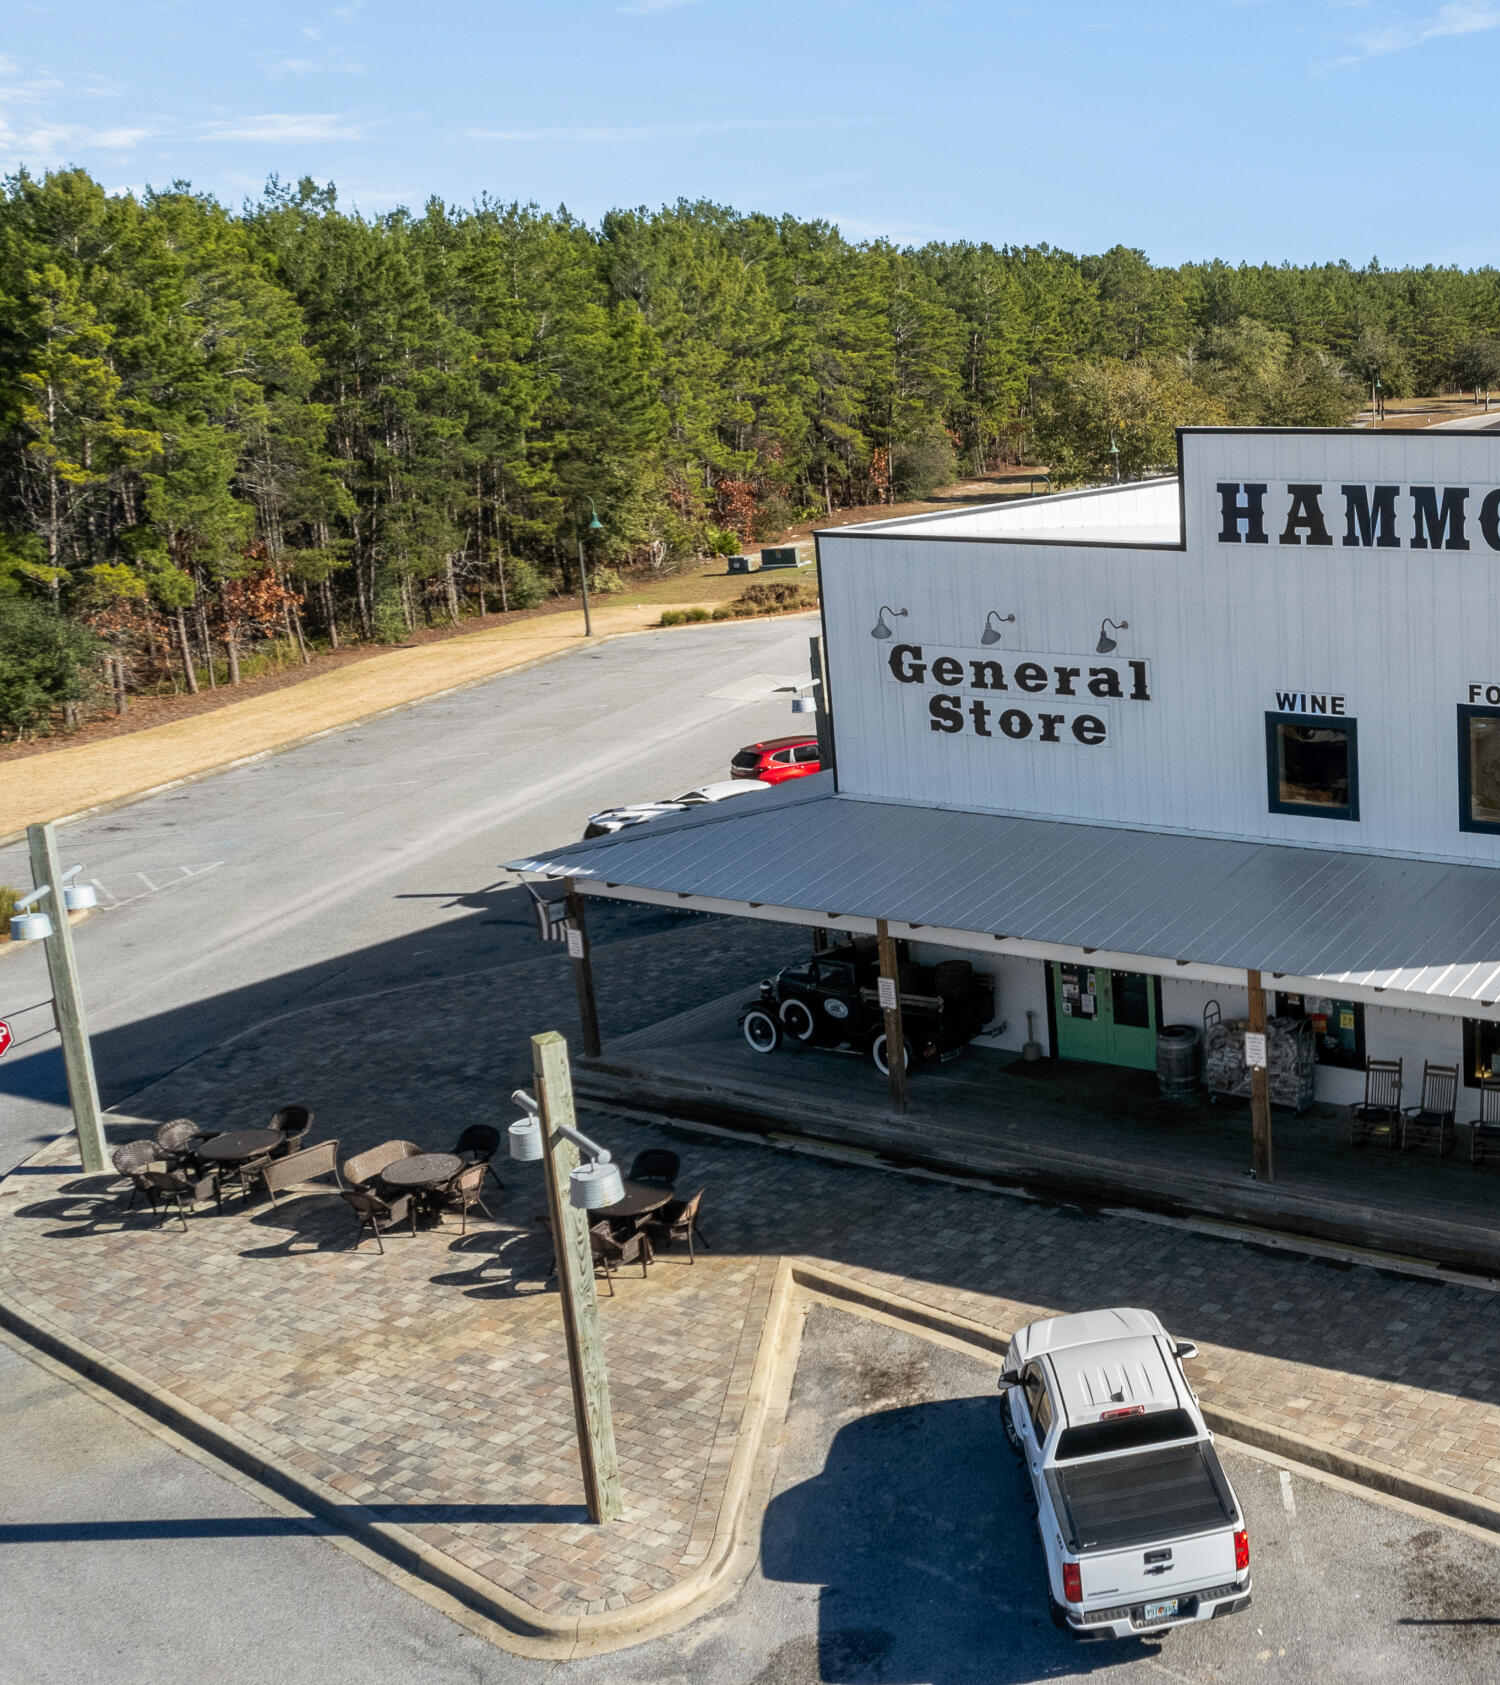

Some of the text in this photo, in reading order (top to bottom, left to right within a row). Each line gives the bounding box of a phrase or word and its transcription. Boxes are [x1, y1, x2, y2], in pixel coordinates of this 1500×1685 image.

[888, 643, 1151, 701] General
[929, 693, 1107, 746] Store
[1275, 692, 1345, 716] WINE
